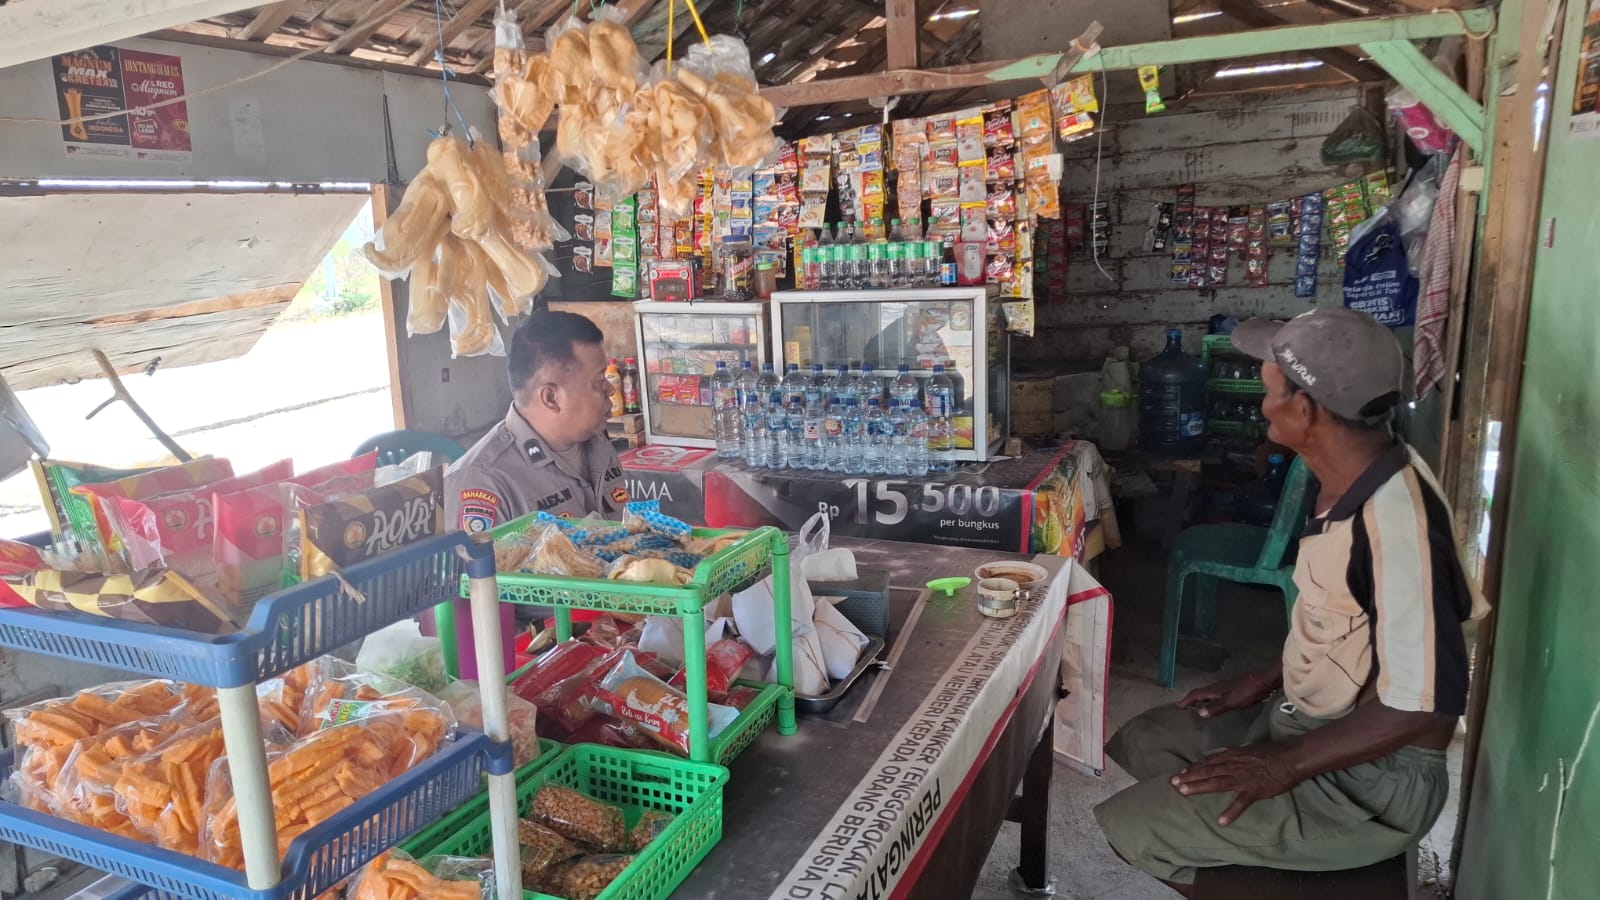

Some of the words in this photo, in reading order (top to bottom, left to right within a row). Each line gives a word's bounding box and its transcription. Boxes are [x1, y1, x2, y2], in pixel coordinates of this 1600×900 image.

[68, 66, 108, 78] MAX
[818, 501, 840, 519] Rp
[940, 518, 956, 528] per
[958, 518, 1000, 531] bungkus
[957, 653, 984, 674] ATAU
[923, 673, 969, 718] MEMBERI
[888, 718, 936, 763] KEPADA
[916, 716, 963, 765] KANKER
[853, 765, 901, 813] ORANG
[833, 765, 930, 878] TENGGOROKAN.
[797, 814, 866, 882] BERUSIA
[783, 884, 814, 900] D
